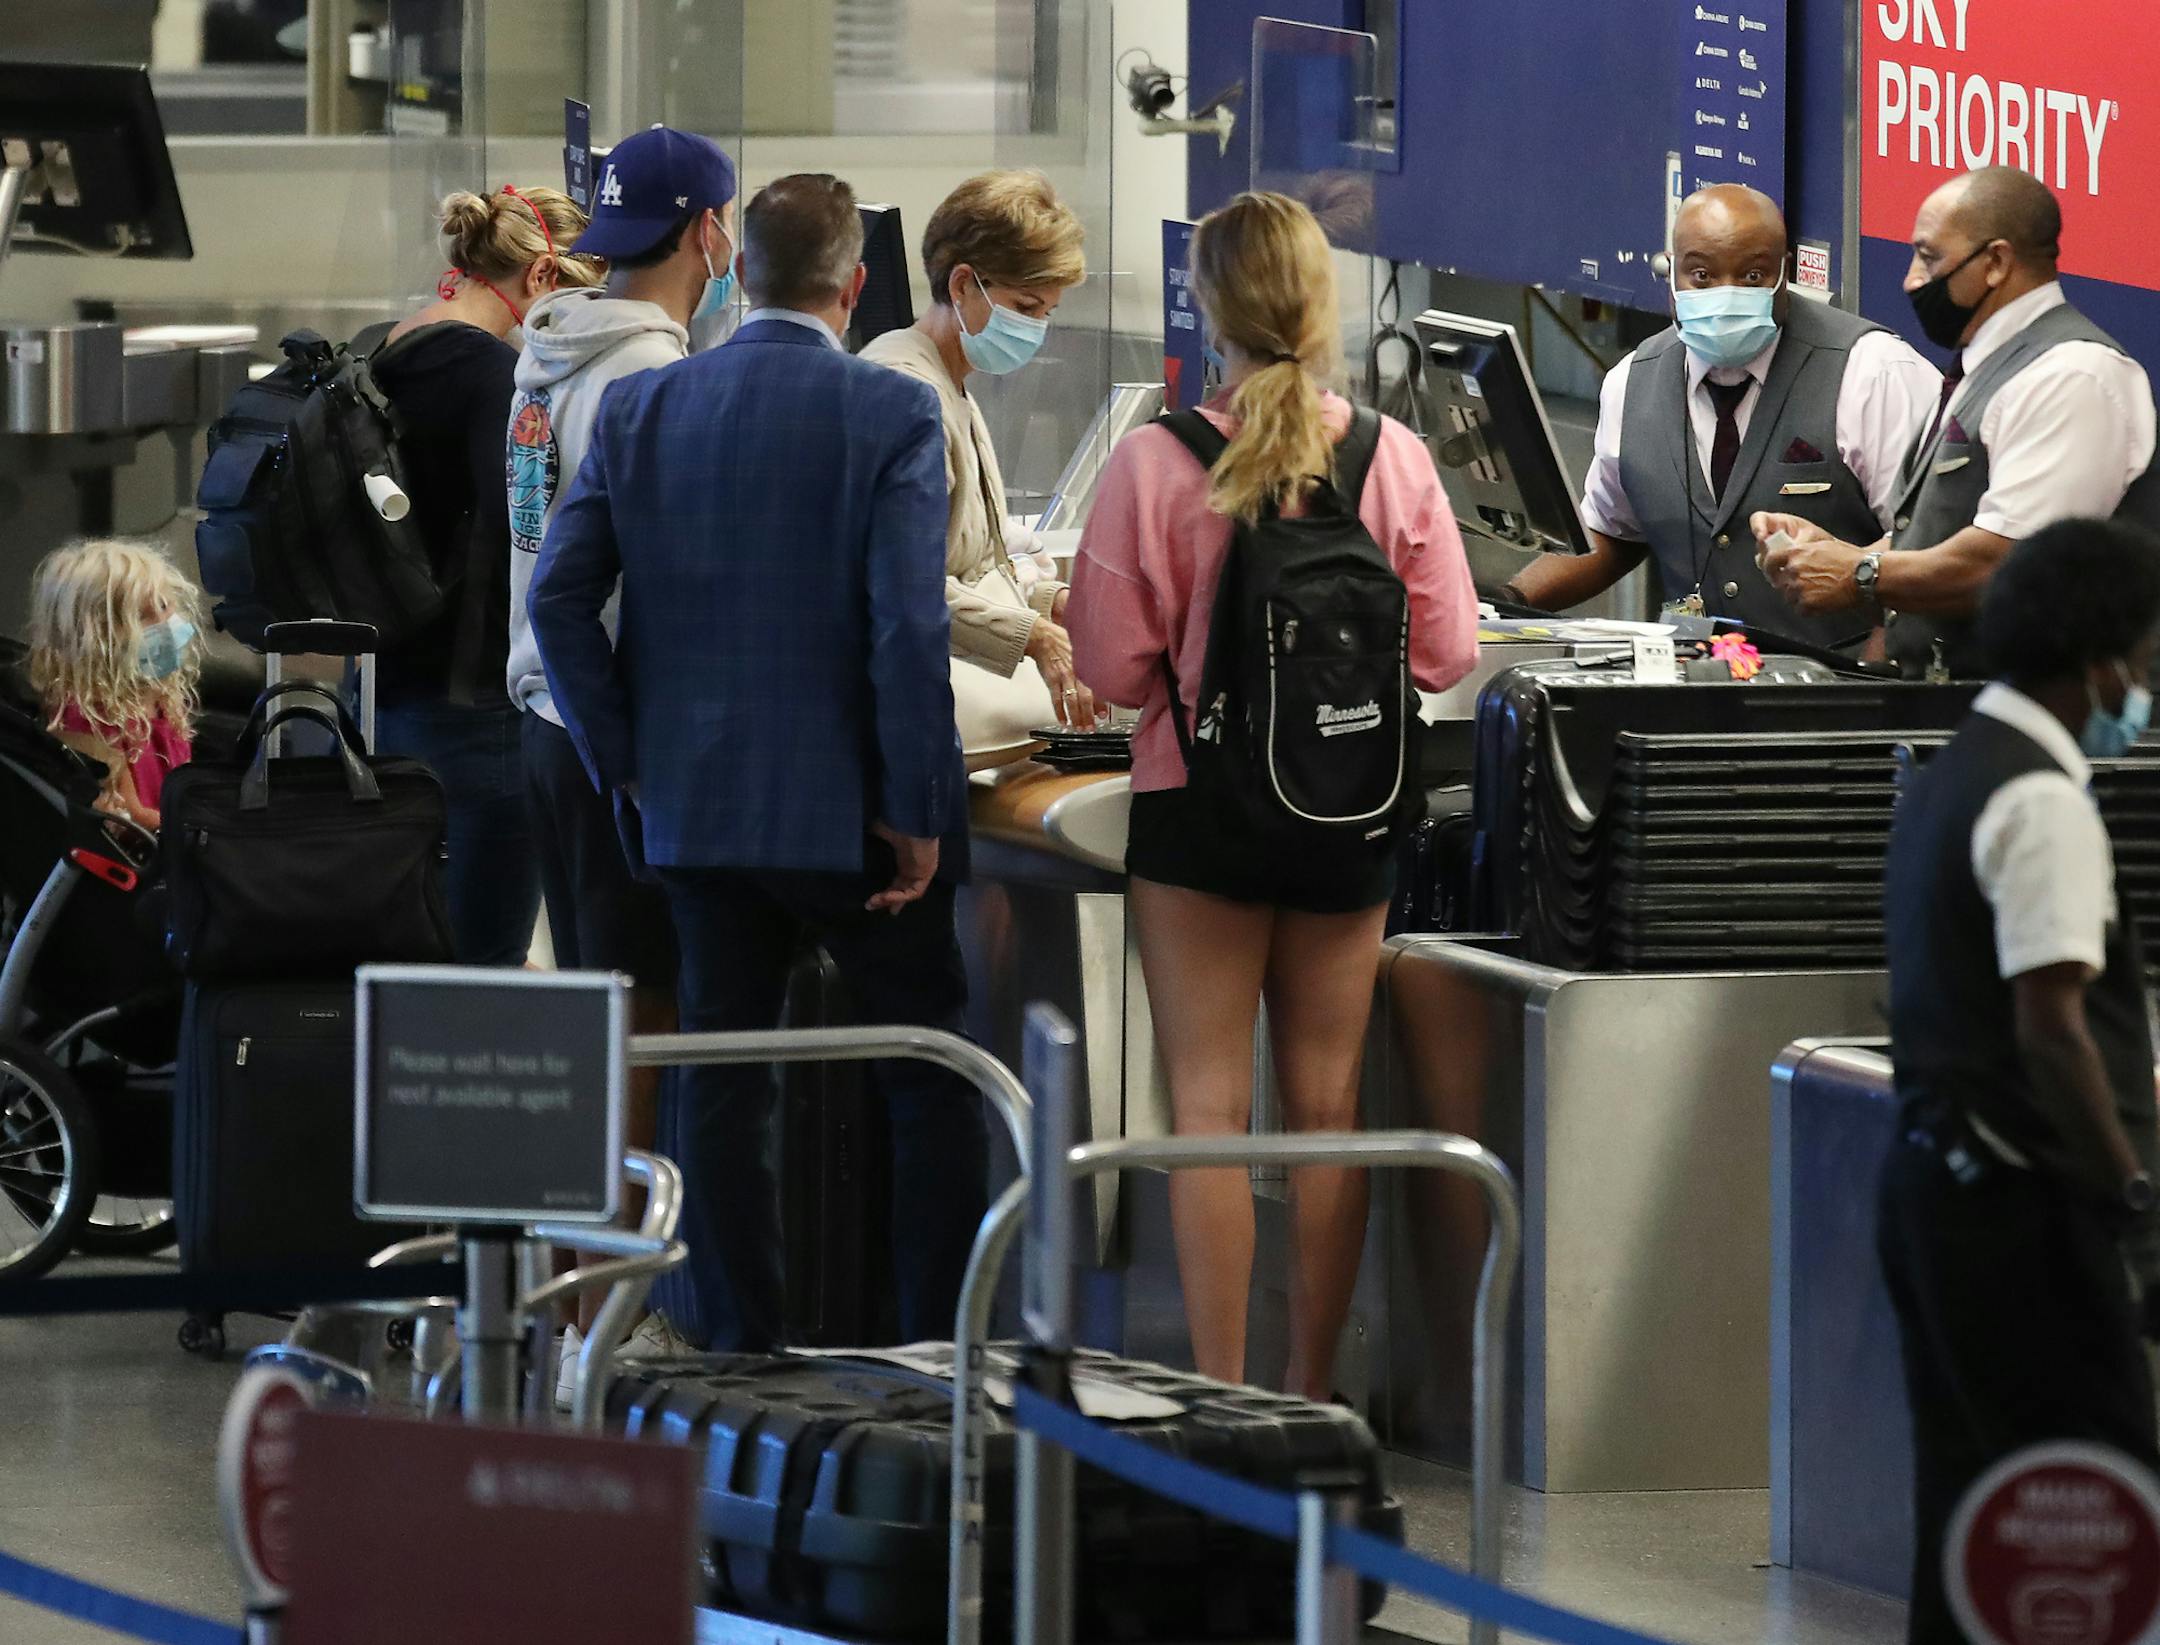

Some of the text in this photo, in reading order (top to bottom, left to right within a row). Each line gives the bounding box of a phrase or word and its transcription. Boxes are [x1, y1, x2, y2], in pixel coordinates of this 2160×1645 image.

[1701, 78, 1720, 90] DELTA
[601, 163, 622, 206] LA
[1800, 251, 1825, 270] PUSH
[514, 511, 540, 524] SIN
[1316, 699, 1380, 725] Minnesota
[387, 1046, 448, 1074] Please
[964, 1344, 984, 1542] DELTA
